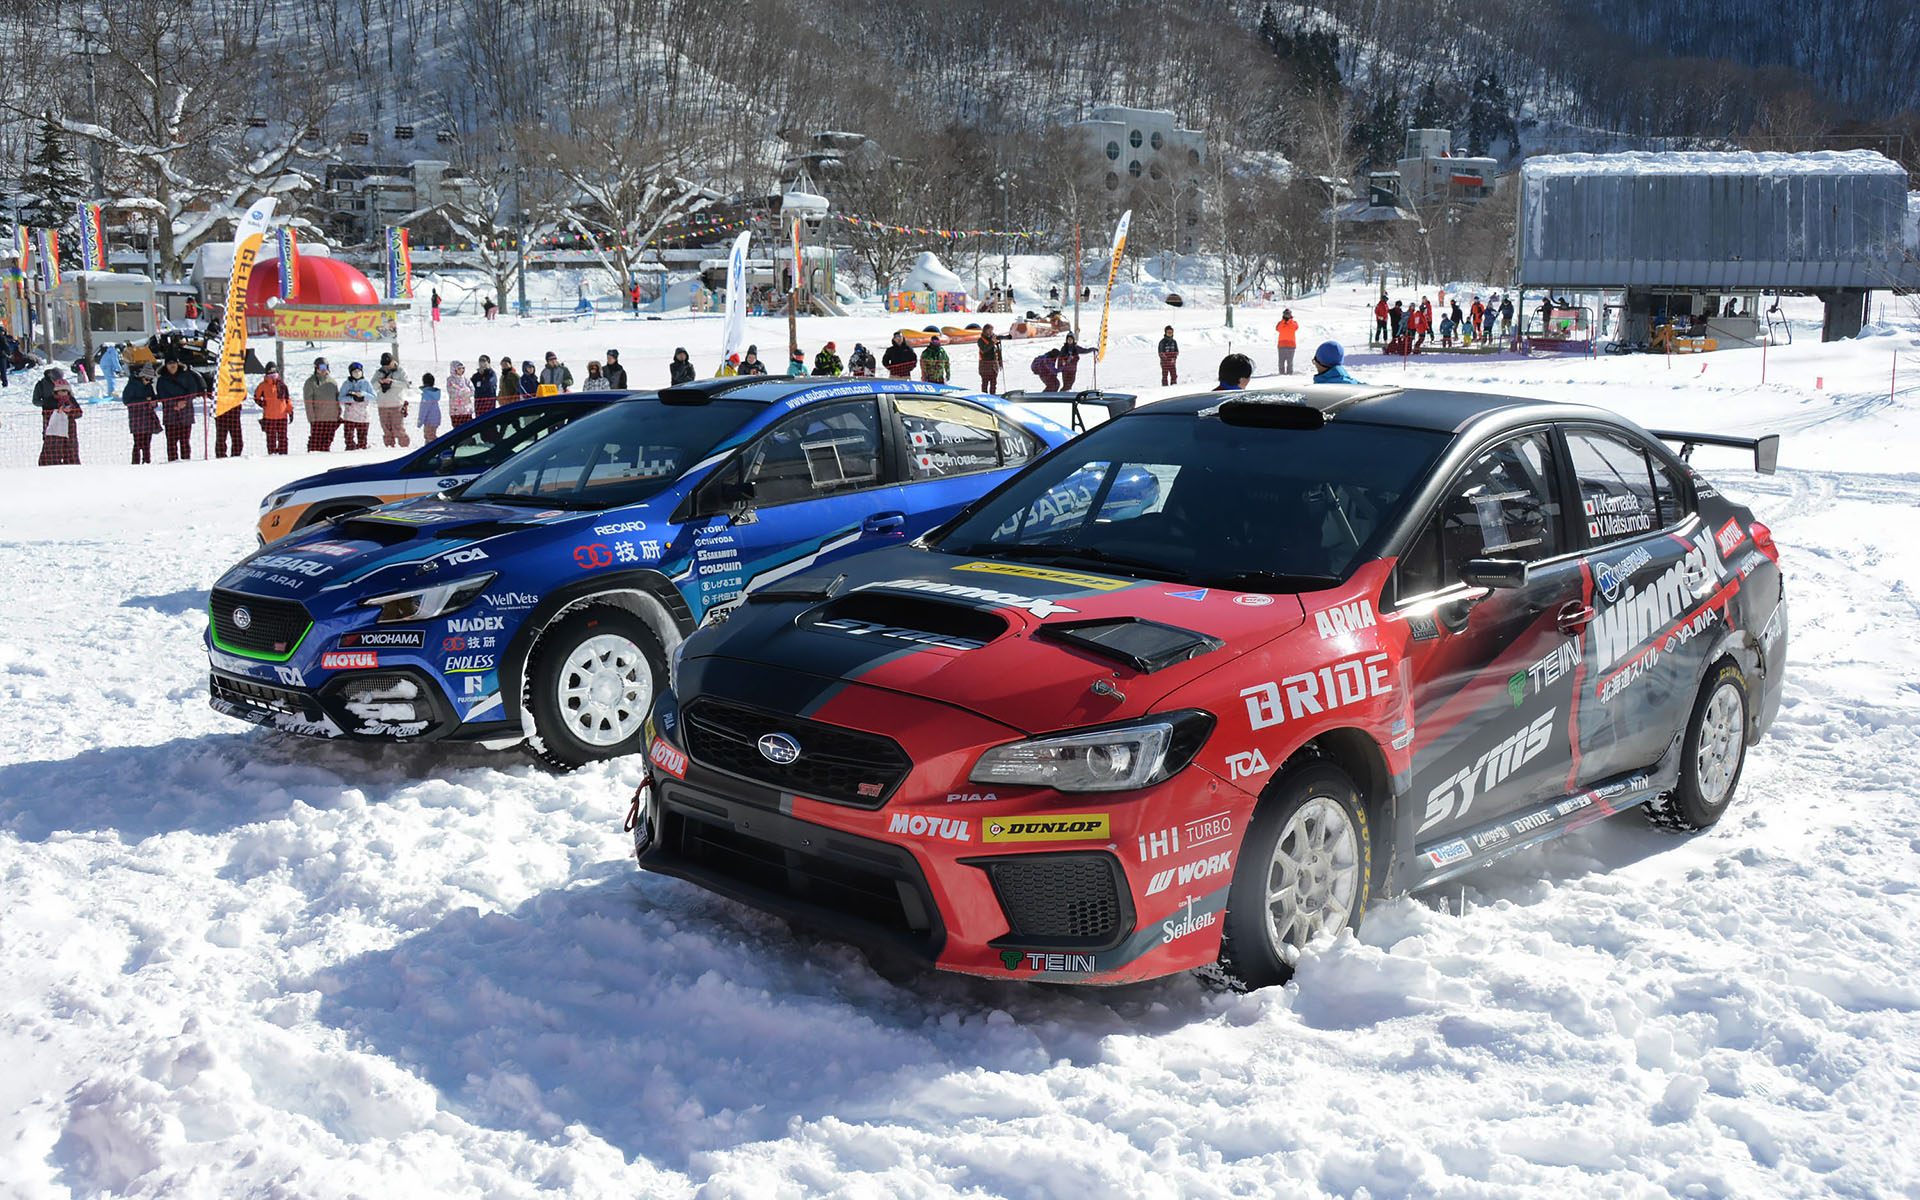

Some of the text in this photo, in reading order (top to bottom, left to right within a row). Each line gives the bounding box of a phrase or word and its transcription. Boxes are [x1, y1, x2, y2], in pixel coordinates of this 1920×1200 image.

[275, 313, 377, 327] スノートレイン
[277, 328, 310, 338] SNOW
[1003, 435, 1029, 456] JN1
[593, 520, 647, 536] RECARO
[1595, 511, 1651, 537] Y.Matsumoto
[443, 547, 489, 566] TOA
[614, 540, 661, 562] 技研
[247, 555, 333, 577] SUBARU
[699, 561, 742, 575] GOLDWIN
[266, 574, 304, 589] ARAI
[447, 616, 504, 633] NADEX
[1314, 599, 1377, 640] ARMA
[361, 634, 420, 645] YOKOHAMA
[467, 636, 496, 649] 技研
[323, 653, 376, 667] MOTUL
[444, 654, 495, 671] ENDLESS
[1528, 634, 1583, 695] TEIN
[273, 665, 307, 687] TOA
[1600, 646, 1660, 704] 北海道スバル
[1239, 652, 1393, 731] BRIDE
[650, 740, 685, 775] MOTUL
[1224, 747, 1271, 781] TOA
[947, 792, 998, 802] PIAA
[888, 813, 971, 842] MOTUL
[1006, 820, 1102, 835] DUNLOP
[1138, 816, 1232, 863] IHI TURBO
[1177, 849, 1233, 887] WORK
[1162, 895, 1217, 944] Seiken
[1025, 952, 1096, 973] TEIN
